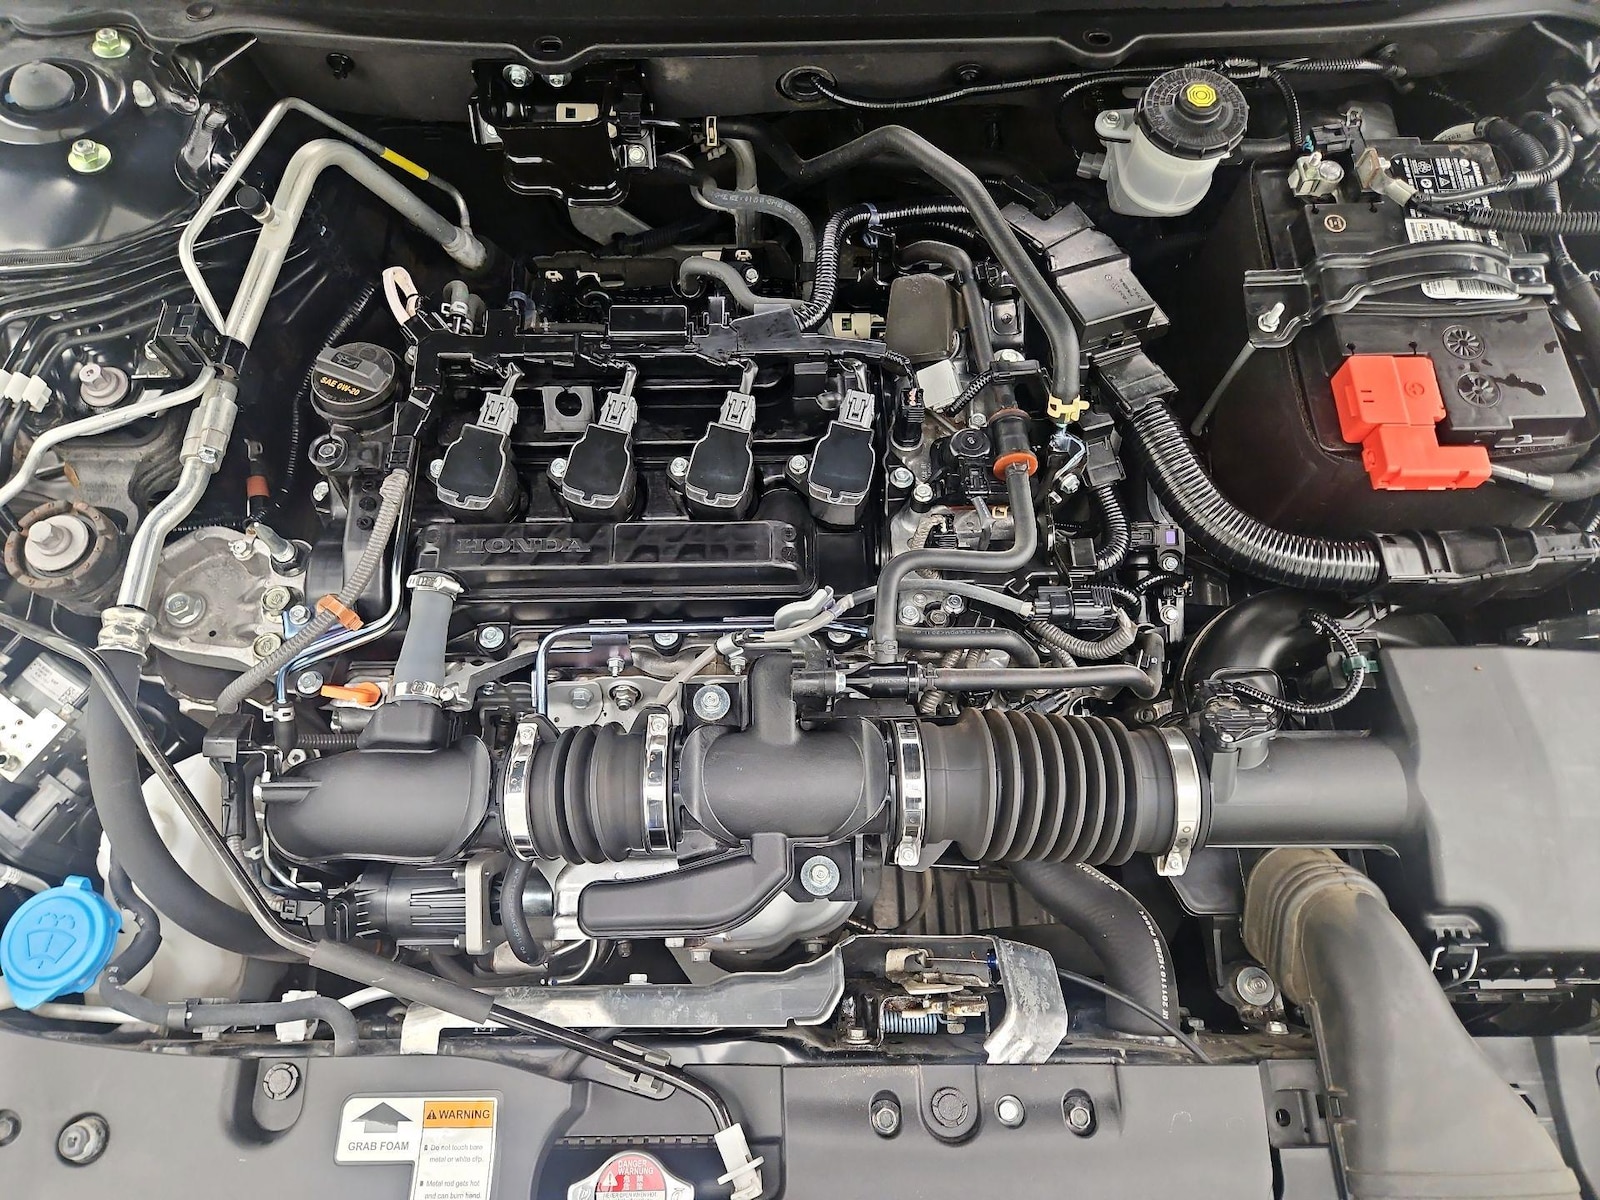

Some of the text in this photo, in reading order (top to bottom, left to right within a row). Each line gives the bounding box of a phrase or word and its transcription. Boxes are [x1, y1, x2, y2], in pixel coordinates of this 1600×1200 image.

[320, 376, 338, 389] SAE
[336, 383, 361, 397] 0W-20
[456, 537, 591, 554] HONDA
[439, 1109, 491, 1120] WARNING
[348, 1141, 410, 1151] GRAB FOAM
[618, 1159, 647, 1168] DANGER
[617, 1167, 654, 1175] WARNUNG
